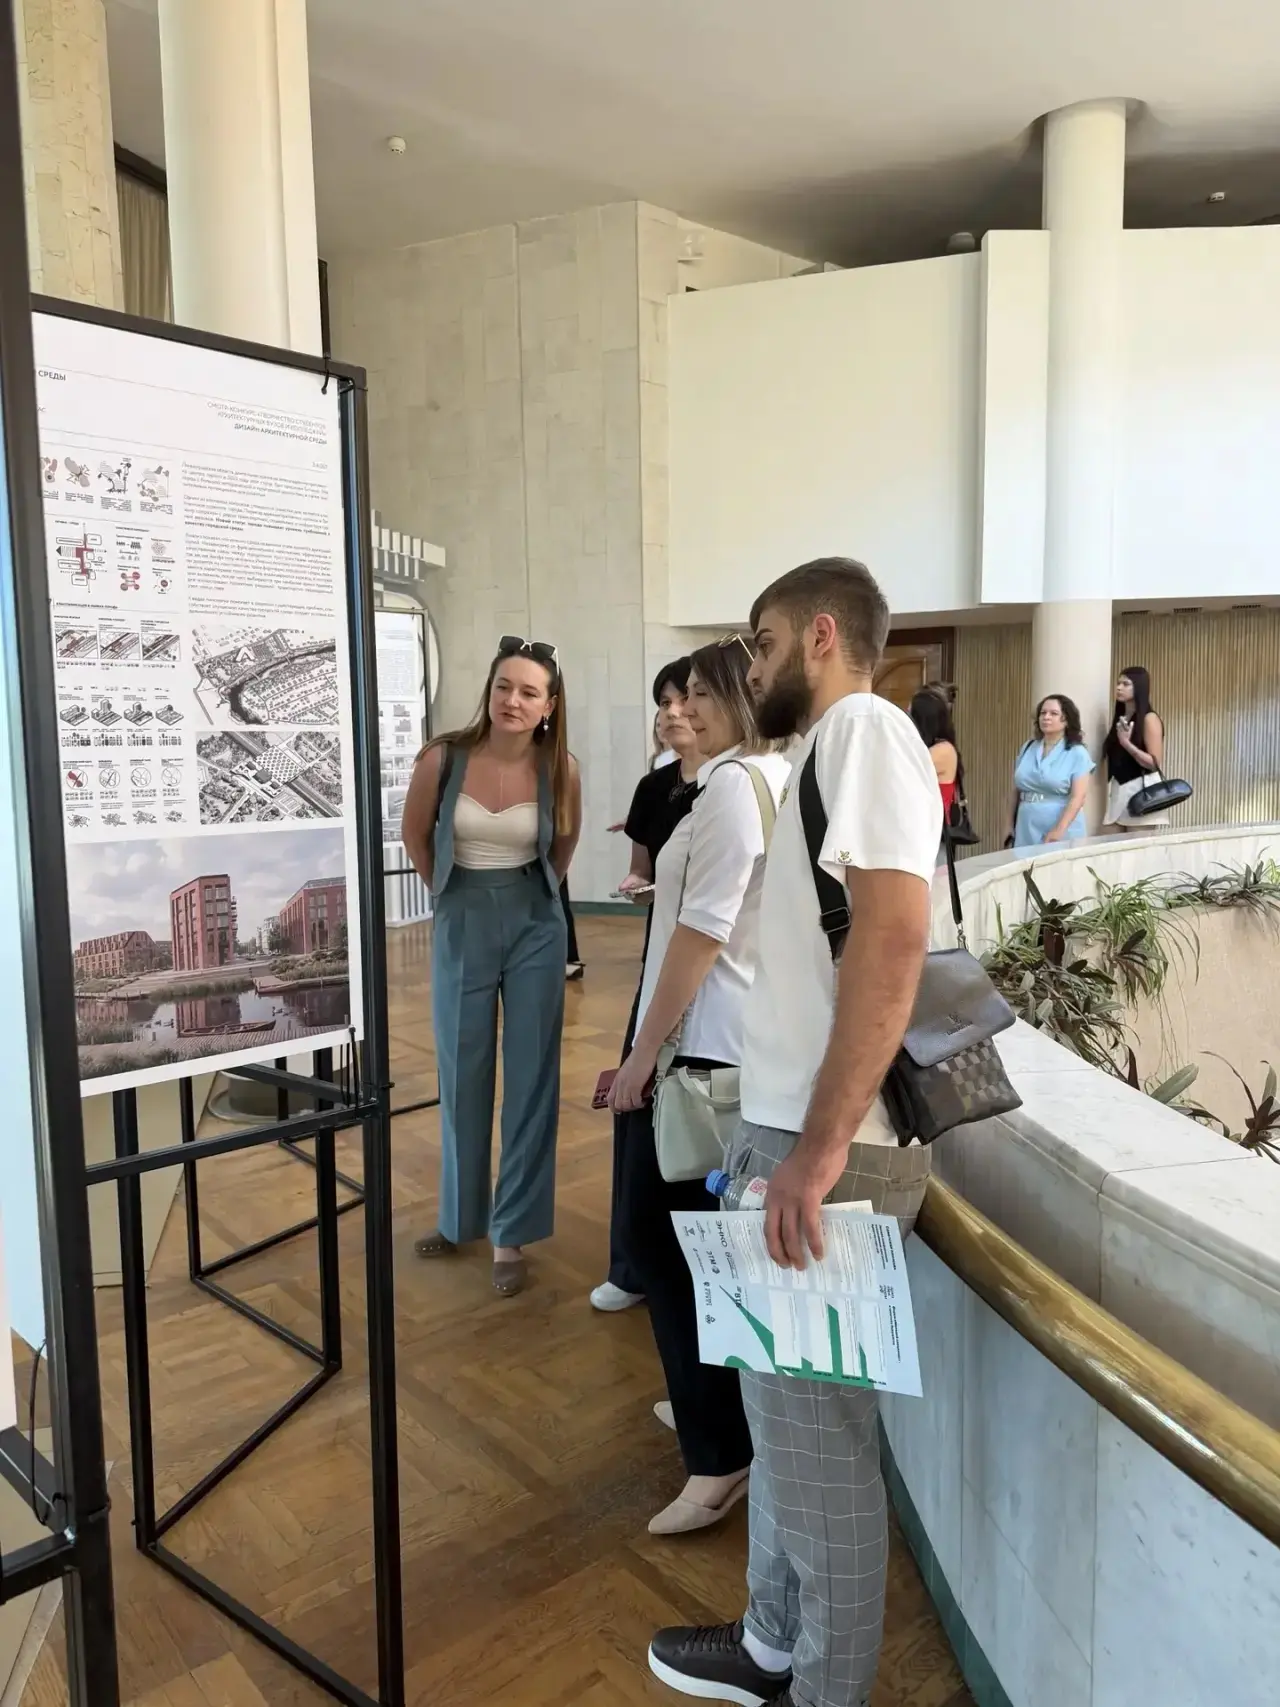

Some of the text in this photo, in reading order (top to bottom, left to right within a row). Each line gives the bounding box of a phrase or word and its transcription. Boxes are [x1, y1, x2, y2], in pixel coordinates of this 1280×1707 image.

[38, 370, 66, 381] СРЕДЫ
[234, 423, 327, 445] ДИЗАЙН АРХИТЕКТУРНОЙ СРЕДЫ
[716, 1219, 727, 1248] ЭНКО
[706, 1250, 716, 1265] ЭТМ
